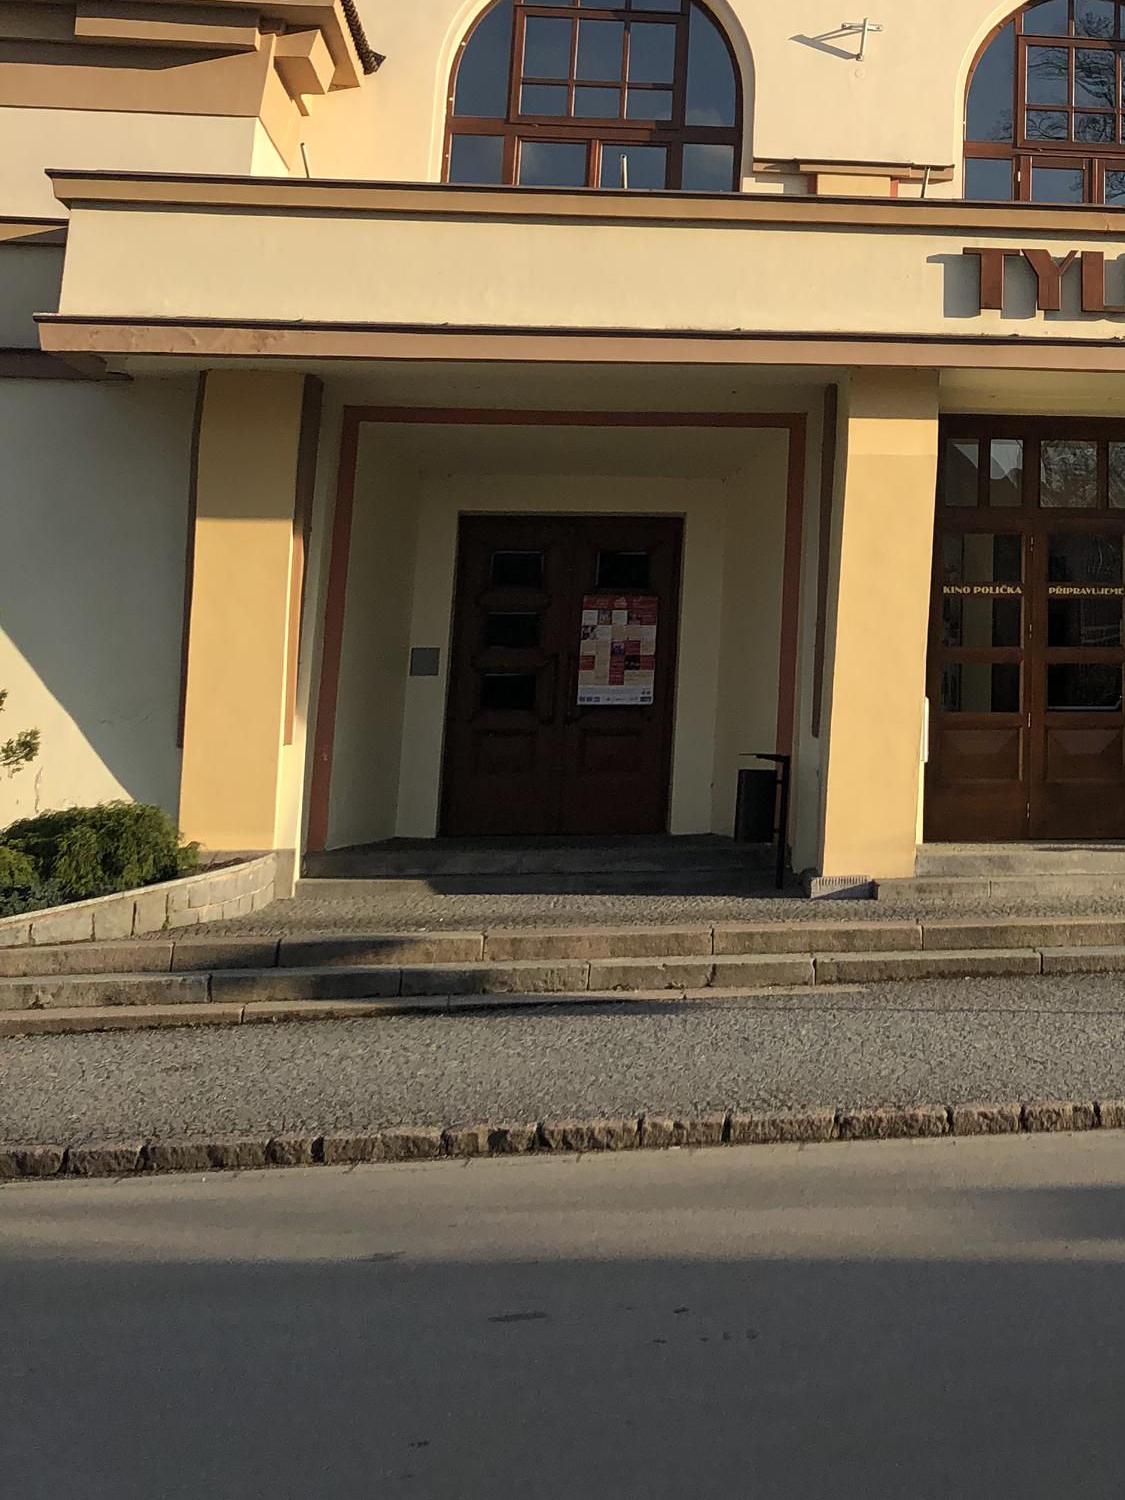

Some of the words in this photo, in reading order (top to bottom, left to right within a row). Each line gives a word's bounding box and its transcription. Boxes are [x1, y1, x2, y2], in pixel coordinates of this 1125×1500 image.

[943, 585, 971, 594] KINO
[973, 584, 1022, 594] POLIČKA
[1048, 586, 1124, 596] PŘIPRAVUJEME
